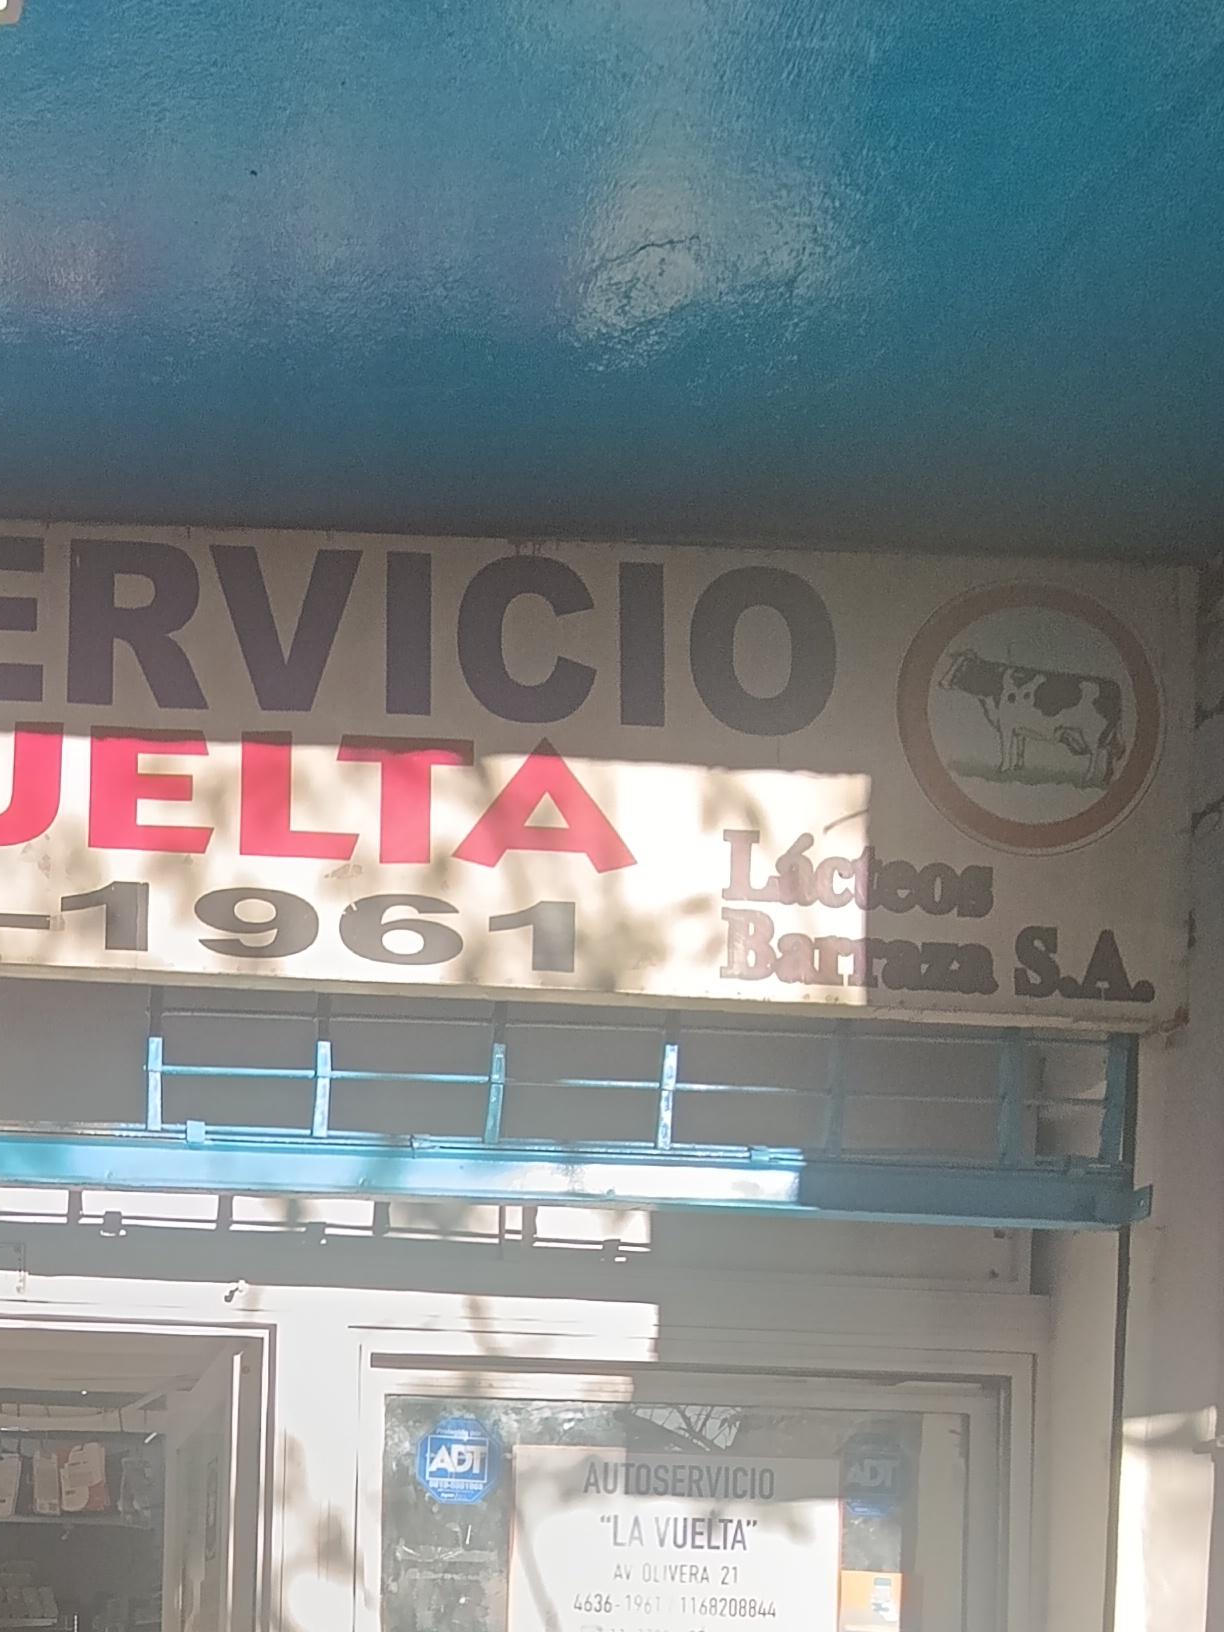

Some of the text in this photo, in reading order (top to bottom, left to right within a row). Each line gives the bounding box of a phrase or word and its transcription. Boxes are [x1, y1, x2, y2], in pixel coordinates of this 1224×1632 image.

[721, 829, 993, 918] Lácteos
[721, 908, 1155, 1001] Barraza S.A.
[428, 1444, 487, 1474] ADT
[583, 1462, 775, 1501] AUTOSERVICIO
[613, 1562, 739, 1585] AV OLIVERA 21
[680, 1596, 777, 1618] 1168208844
